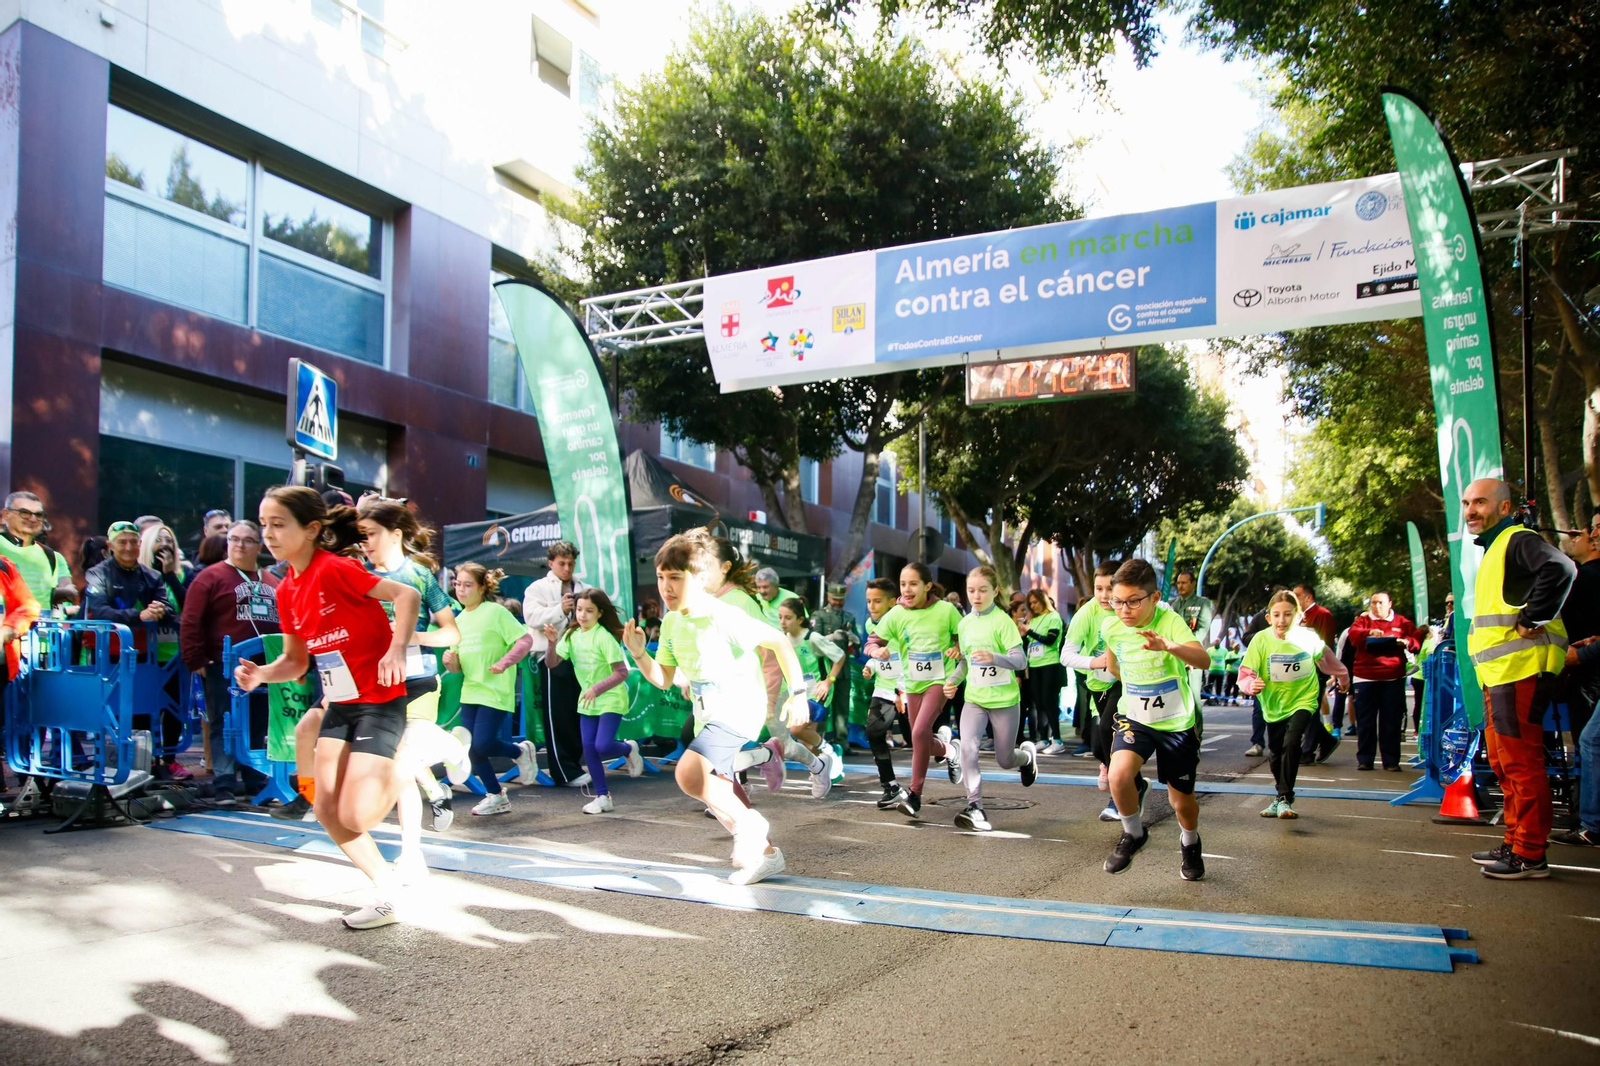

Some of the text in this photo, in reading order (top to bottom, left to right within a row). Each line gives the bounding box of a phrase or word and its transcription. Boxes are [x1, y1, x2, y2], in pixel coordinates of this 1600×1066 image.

[1261, 205, 1333, 227] cajamar
[895, 222, 1194, 284] Almería en marcha
[1329, 236, 1412, 259] Fundación
[1262, 256, 1311, 267] MICHELIN
[1373, 262, 1402, 276] Ejido
[895, 265, 1151, 319] contra el cáncer
[1267, 284, 1302, 294] Toyota
[1135, 296, 1207, 311] asociación española
[1267, 290, 1340, 306] Alborán Motor
[1136, 306, 1192, 319] contra el cáncer
[1136, 316, 1177, 327] en Almería
[887, 333, 983, 352] #TodosContraElCáncer
[306, 628, 349, 649] SAYMA
[916, 661, 932, 671] 64
[979, 666, 997, 677] 73
[1283, 662, 1301, 673] 76
[1140, 695, 1165, 711] 74
